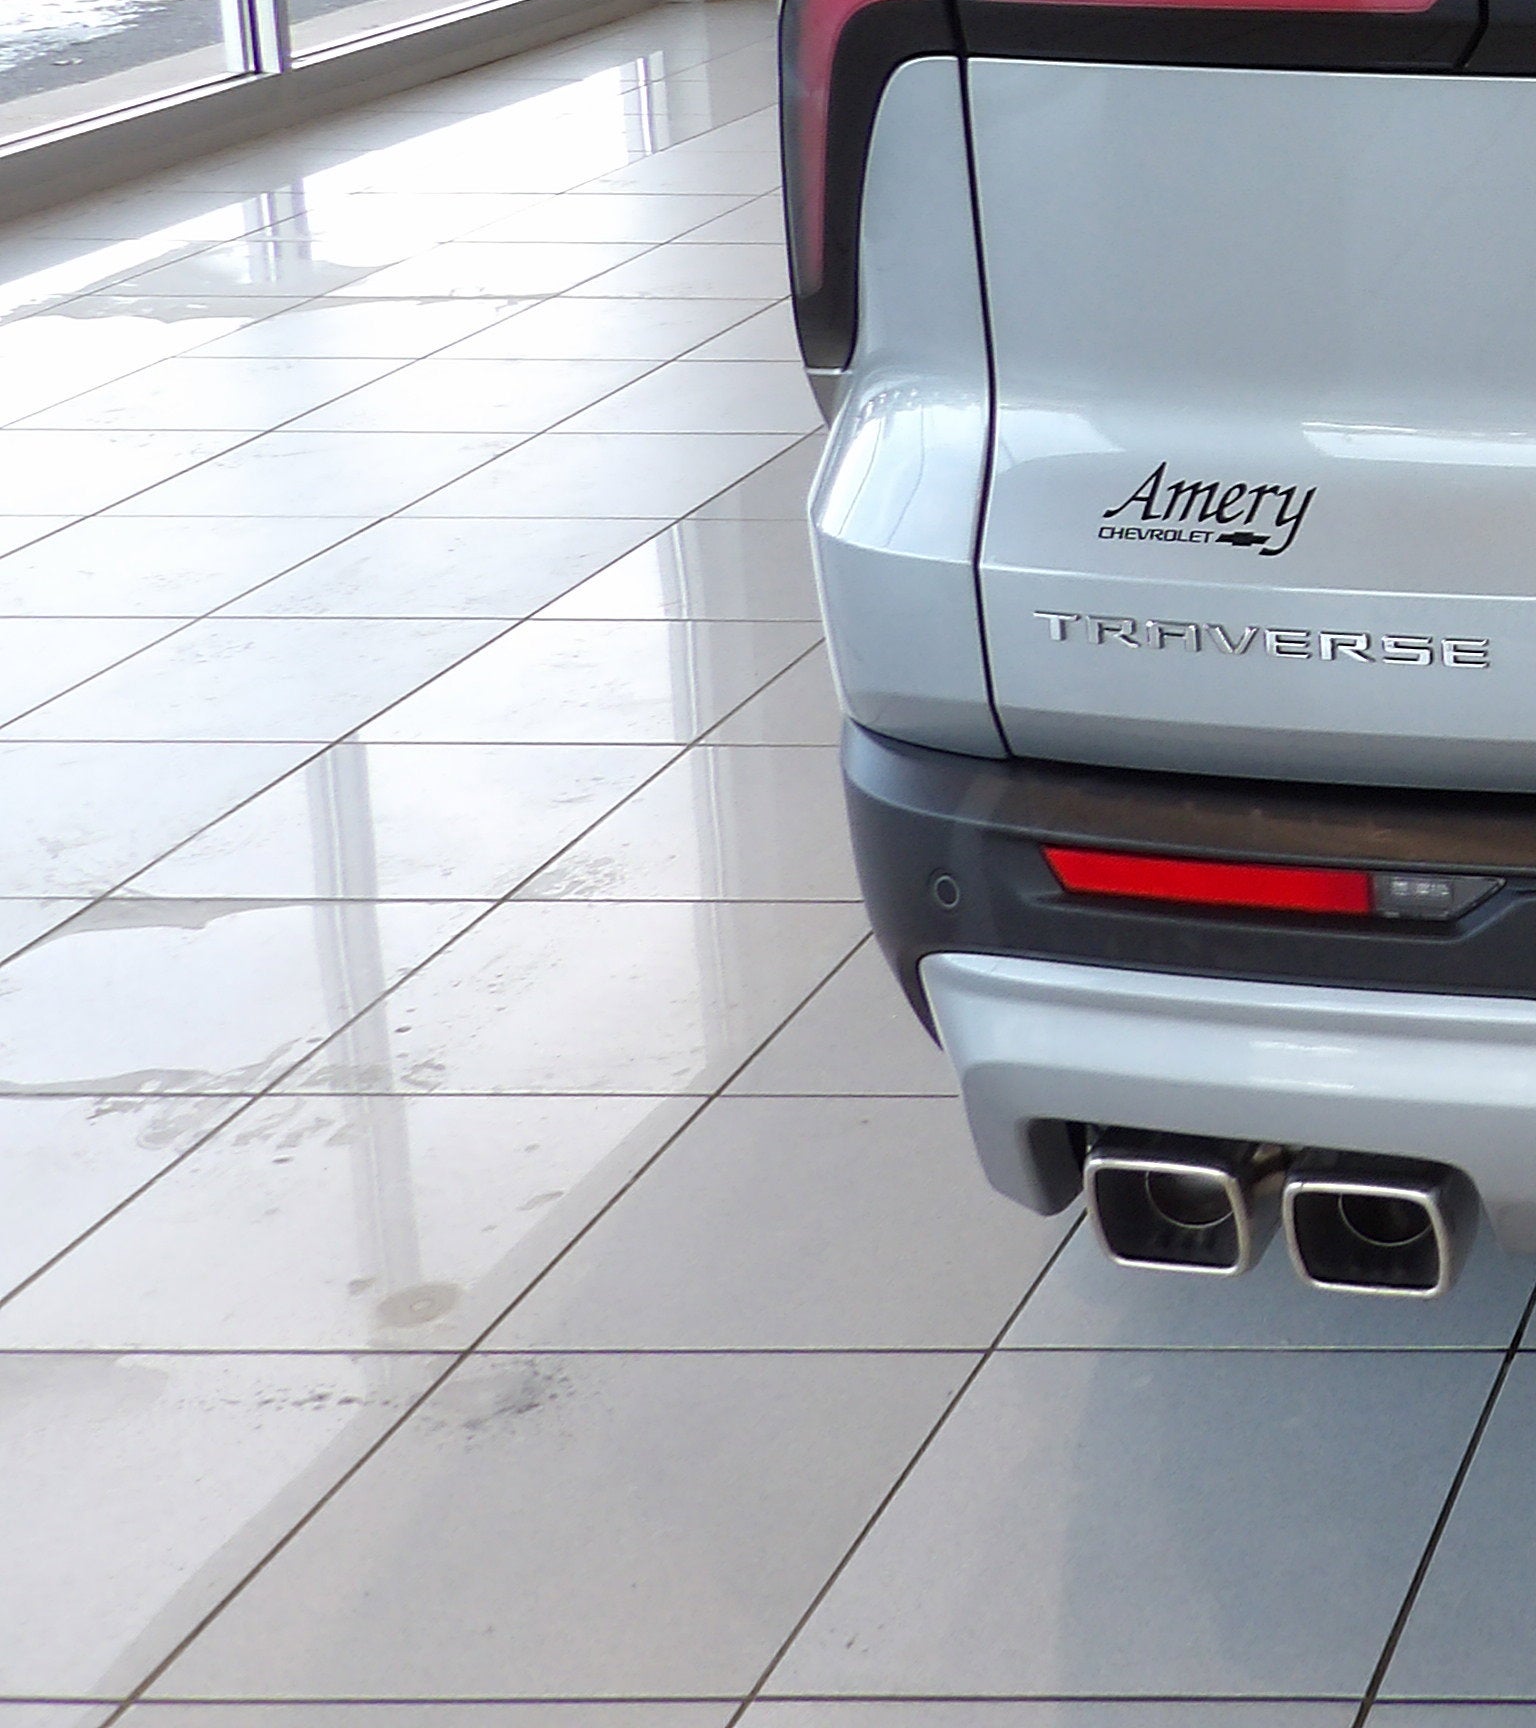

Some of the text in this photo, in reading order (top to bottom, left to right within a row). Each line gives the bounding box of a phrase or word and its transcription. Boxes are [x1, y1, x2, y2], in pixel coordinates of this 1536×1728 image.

[1098, 526, 1215, 543] CHEVROLET
[1102, 461, 1318, 556] Amery
[1033, 610, 1490, 670] TRAVERSE
